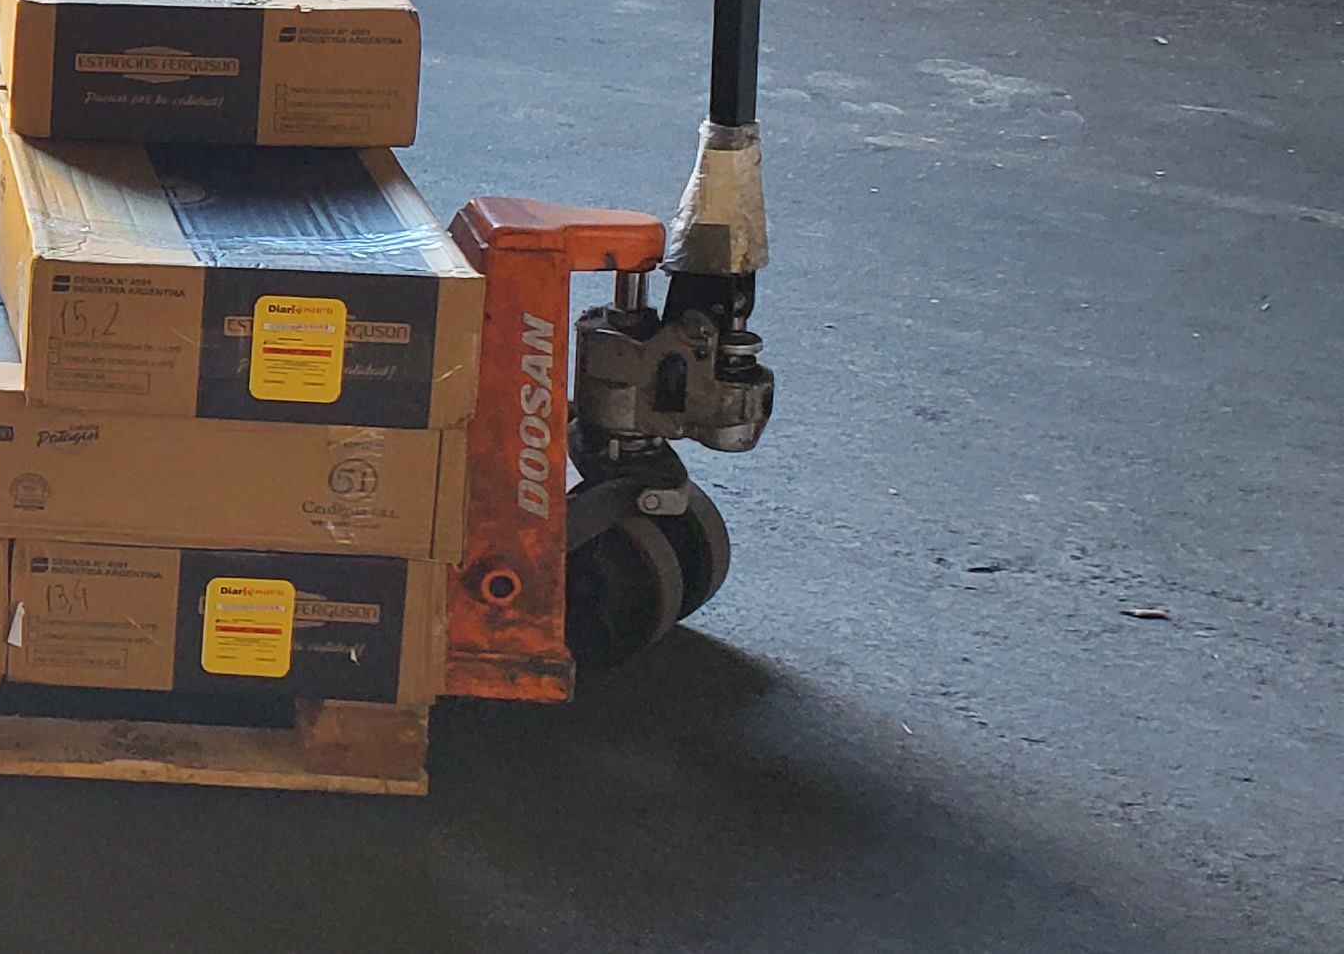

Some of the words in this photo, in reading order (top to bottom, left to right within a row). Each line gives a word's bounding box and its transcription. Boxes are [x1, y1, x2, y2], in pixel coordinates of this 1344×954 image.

[78, 56, 158, 71] ESTANCIAS
[162, 58, 237, 73] FERGUSON
[128, 287, 187, 298] ARGENTINA
[345, 323, 409, 340] RGUSON
[518, 313, 554, 520] DOOSAN
[295, 602, 378, 620] FERGUSON
